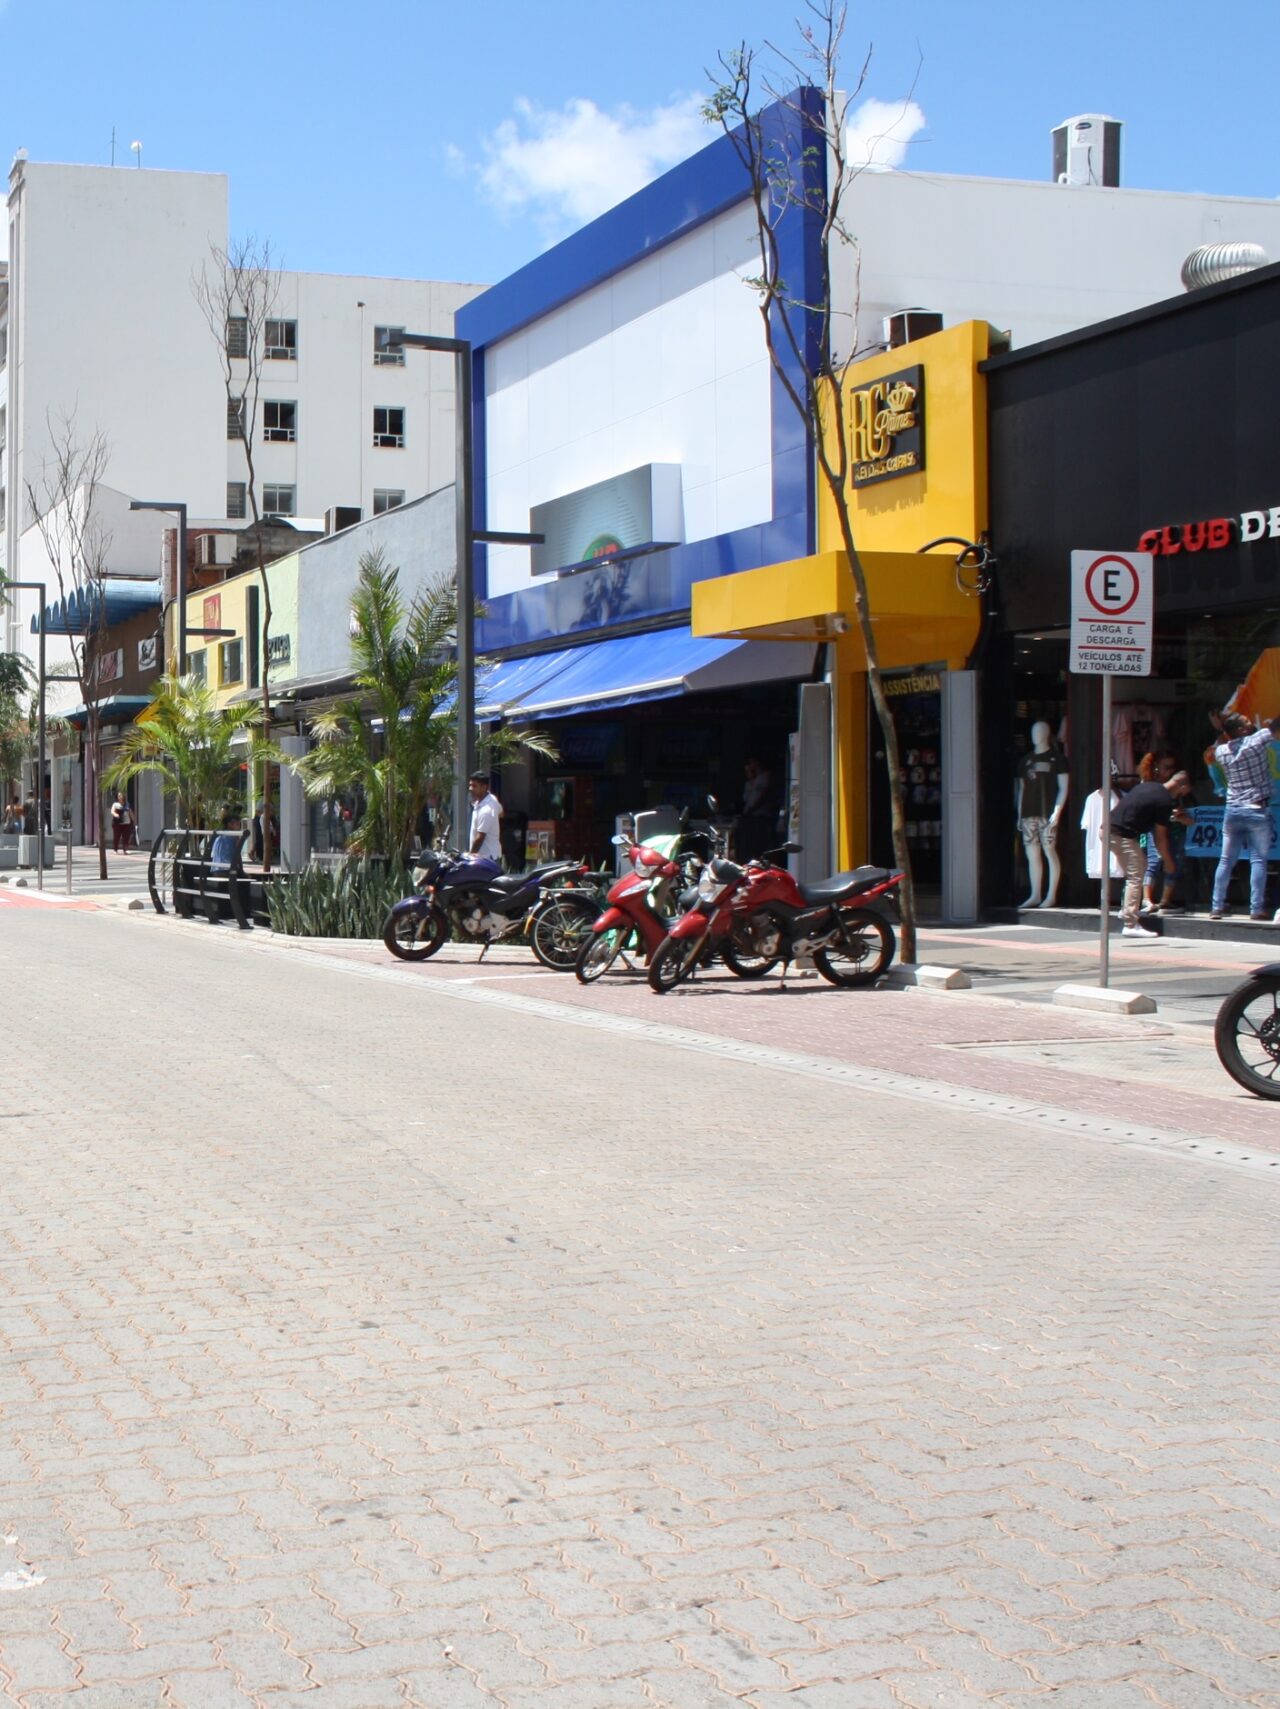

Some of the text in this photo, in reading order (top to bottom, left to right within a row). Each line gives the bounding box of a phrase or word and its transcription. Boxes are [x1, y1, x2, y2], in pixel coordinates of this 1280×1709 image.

[887, 451, 917, 472] CAPAS
[1137, 518, 1231, 555] CLUB
[1104, 570, 1121, 601] E
[1090, 624, 1133, 634] CARGA E
[1086, 635, 1136, 645] DESCARGA
[1078, 652, 1122, 661] VEÍCULOS
[1090, 662, 1142, 672] TONELADAS
